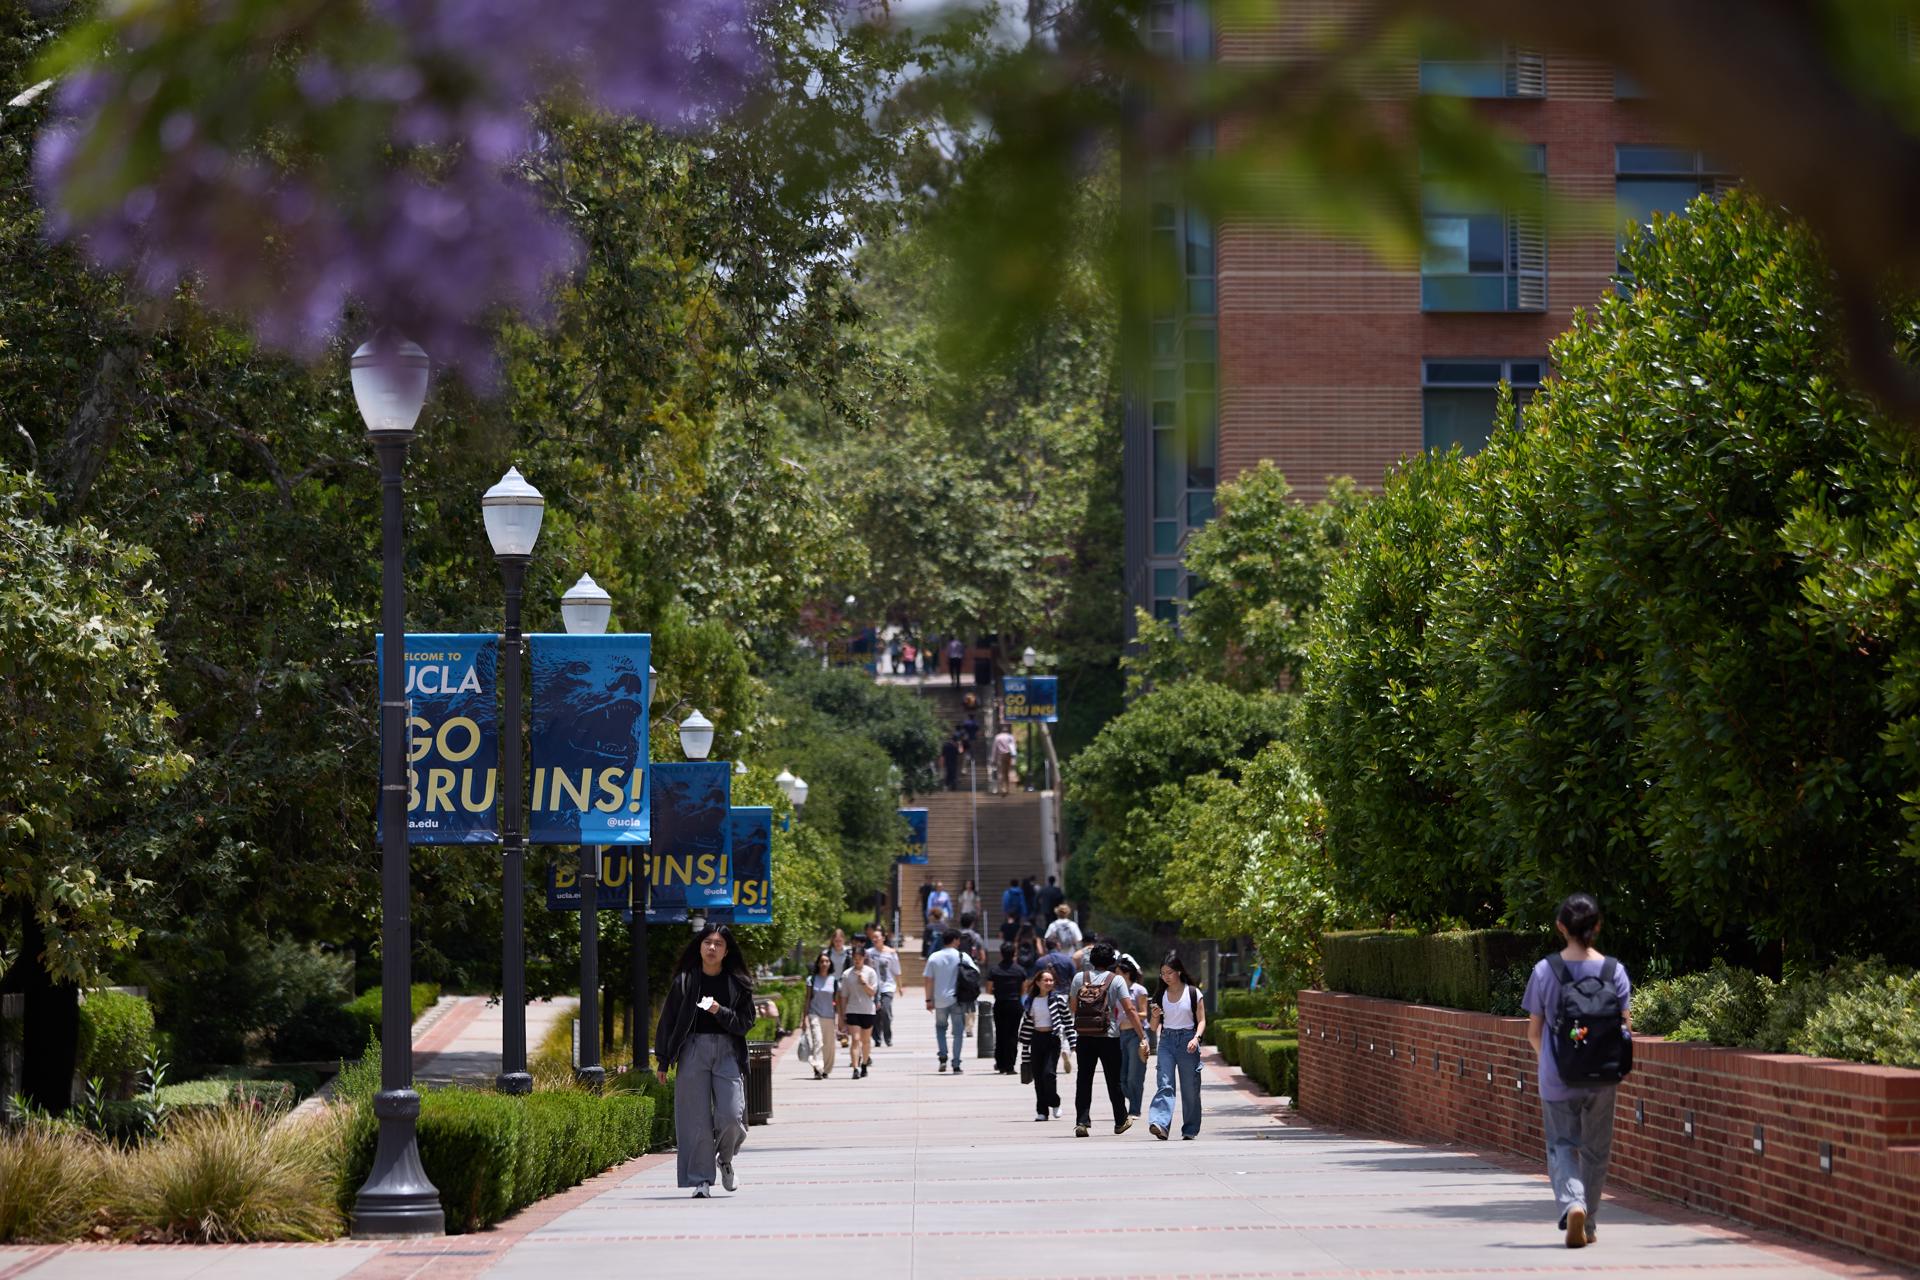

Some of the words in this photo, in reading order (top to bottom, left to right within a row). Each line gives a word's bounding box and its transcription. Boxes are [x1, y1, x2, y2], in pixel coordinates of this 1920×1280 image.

[404, 652, 444, 661] ELCOME
[448, 652, 462, 661] TO
[1005, 694, 1026, 706] GO
[406, 716, 481, 762] GO
[532, 767, 644, 813] INS!
[607, 818, 641, 827] @ucla
[652, 853, 728, 886] INS!
